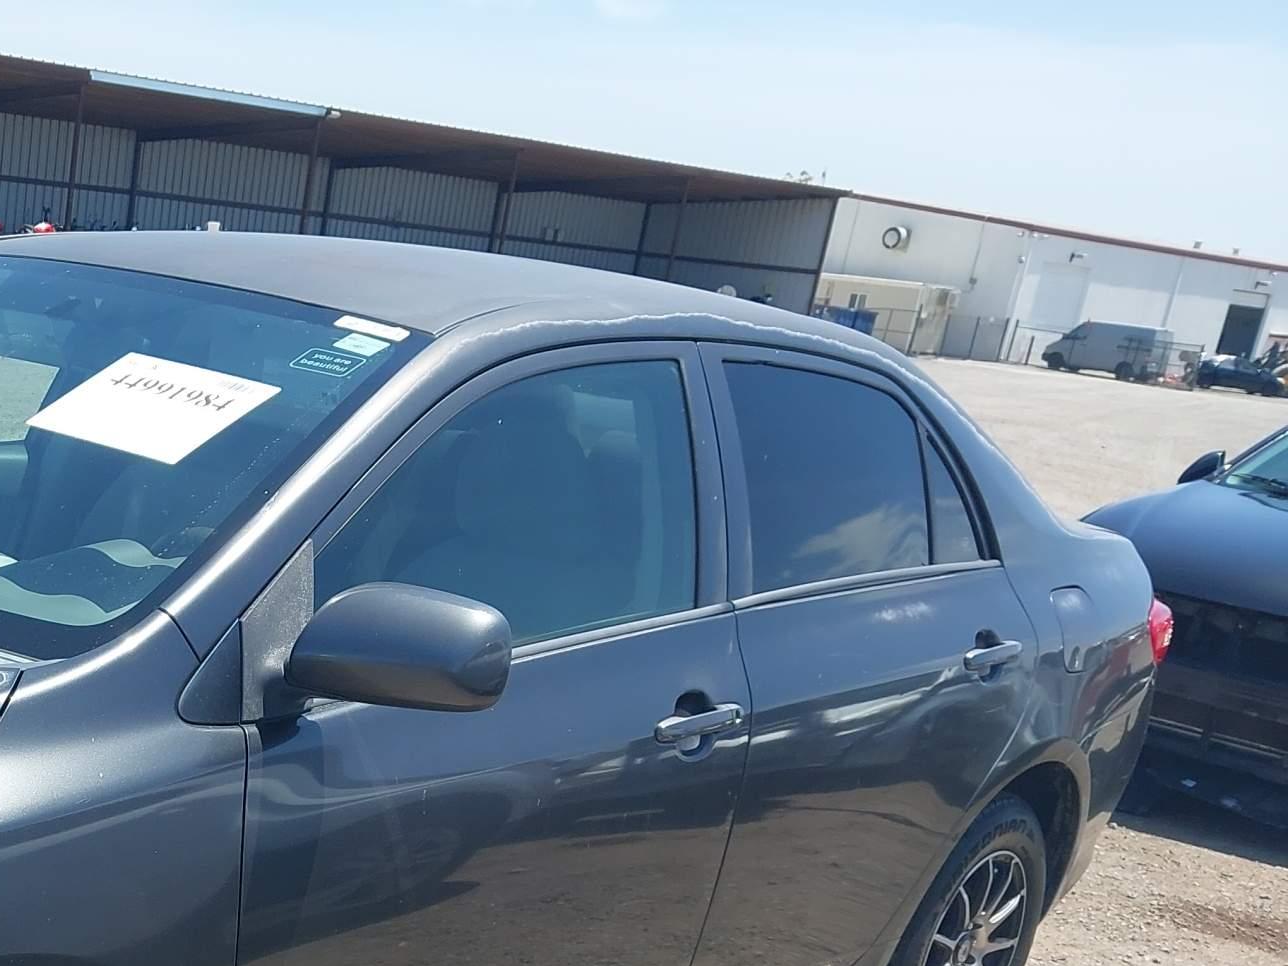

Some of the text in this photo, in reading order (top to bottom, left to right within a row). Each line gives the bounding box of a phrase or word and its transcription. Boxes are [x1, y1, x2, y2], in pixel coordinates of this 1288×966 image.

[312, 353, 333, 361] you
[299, 358, 348, 372] beautiful
[110, 373, 235, 411] 44991984
